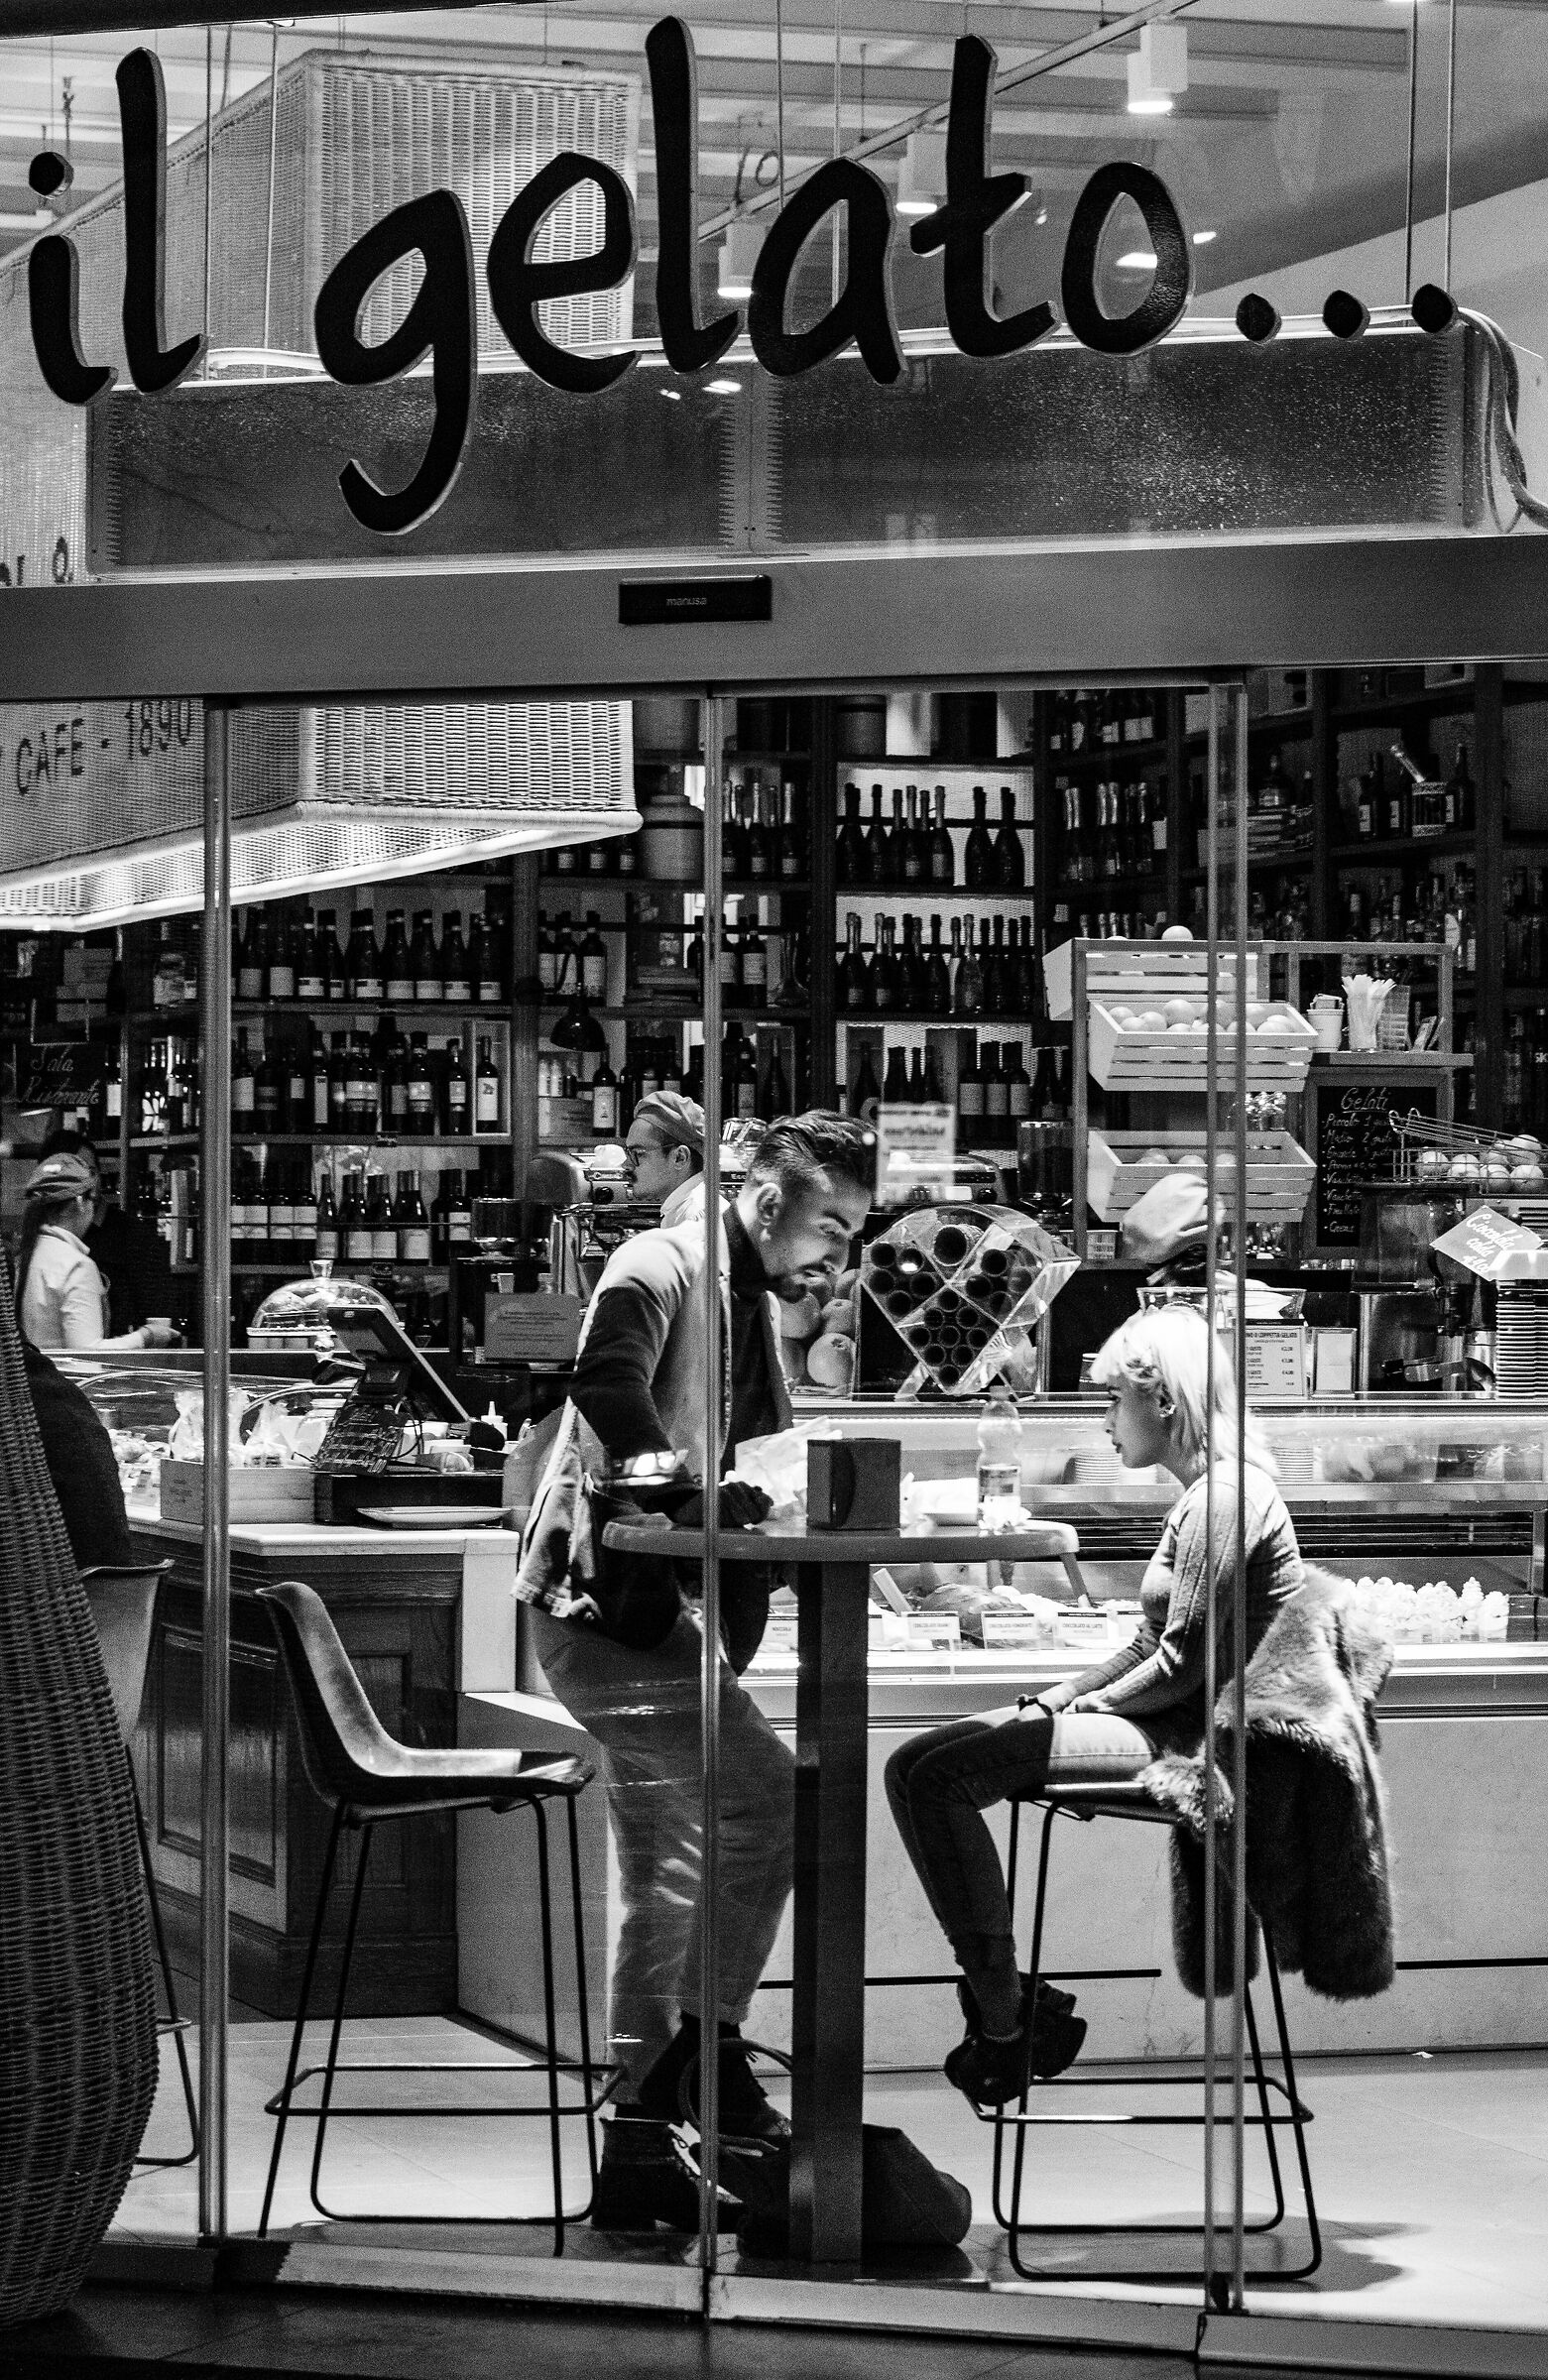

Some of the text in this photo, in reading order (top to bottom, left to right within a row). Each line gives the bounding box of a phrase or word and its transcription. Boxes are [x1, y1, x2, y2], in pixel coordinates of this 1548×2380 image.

[28, 47, 207, 407] il
[666, 597, 707, 607] manusa
[1340, 1087, 1391, 1111] Gelati
